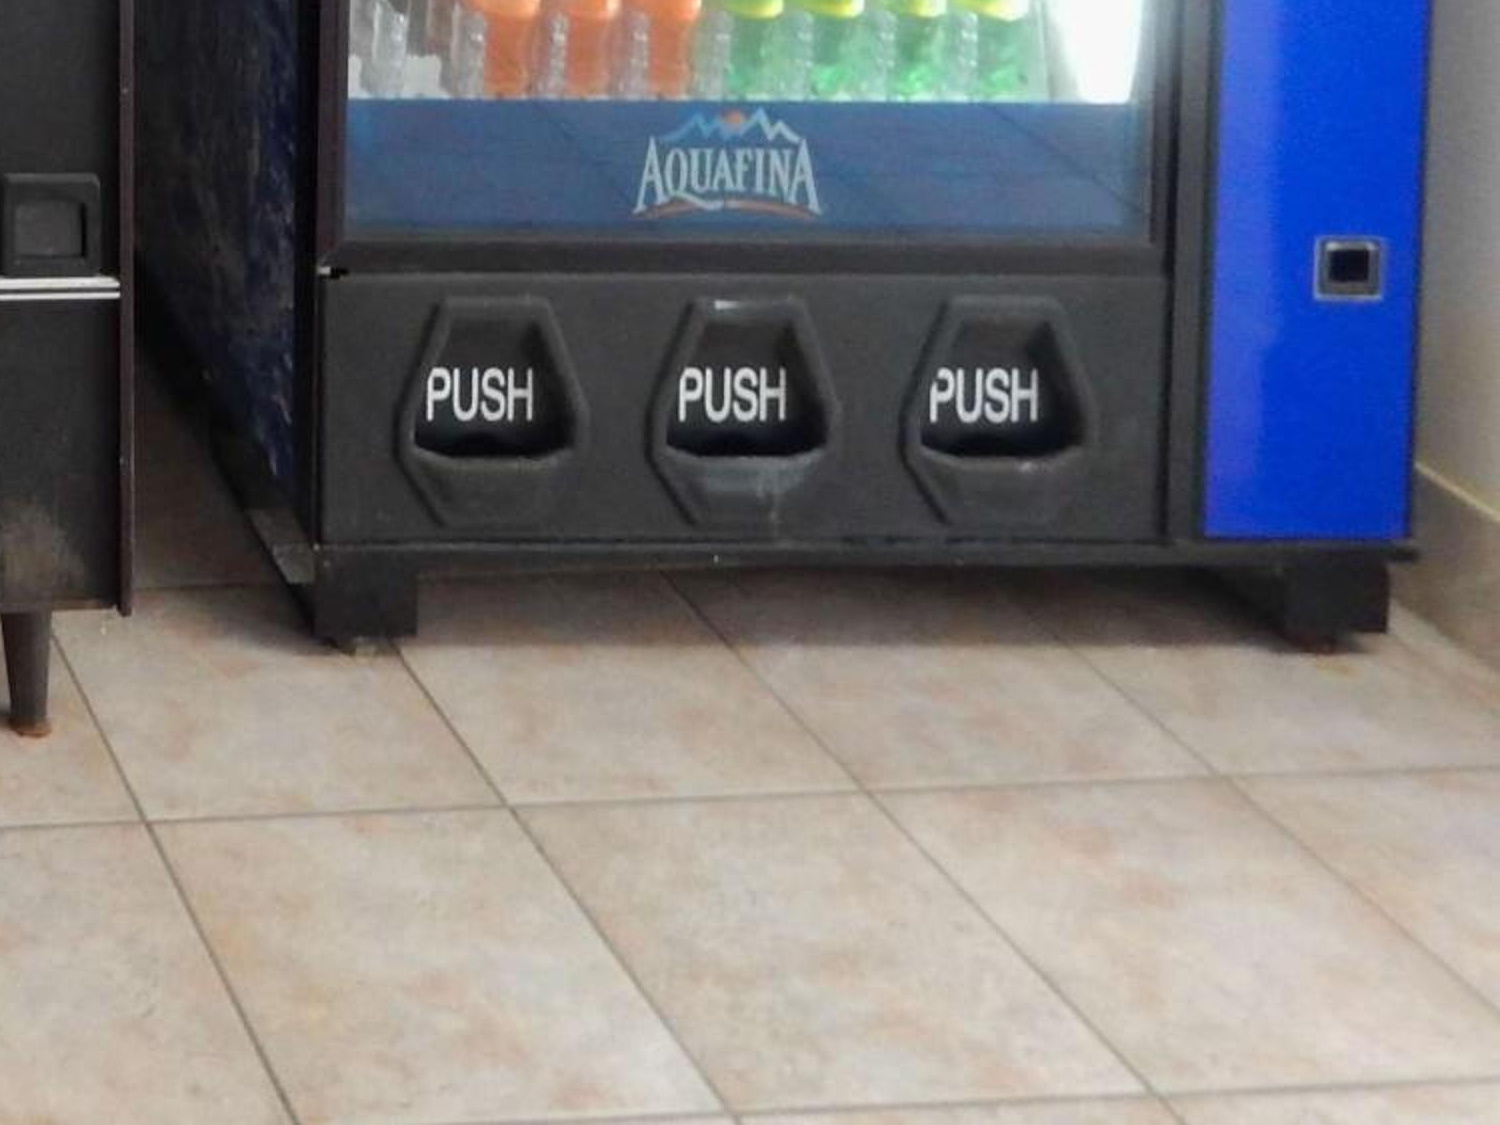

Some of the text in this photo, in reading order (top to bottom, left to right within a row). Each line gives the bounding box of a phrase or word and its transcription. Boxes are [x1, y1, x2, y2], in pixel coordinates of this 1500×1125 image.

[632, 136, 823, 217] AQUAFINA
[426, 368, 534, 422] PUSH
[679, 368, 787, 422] PUSH
[930, 368, 1039, 423] PUSH
